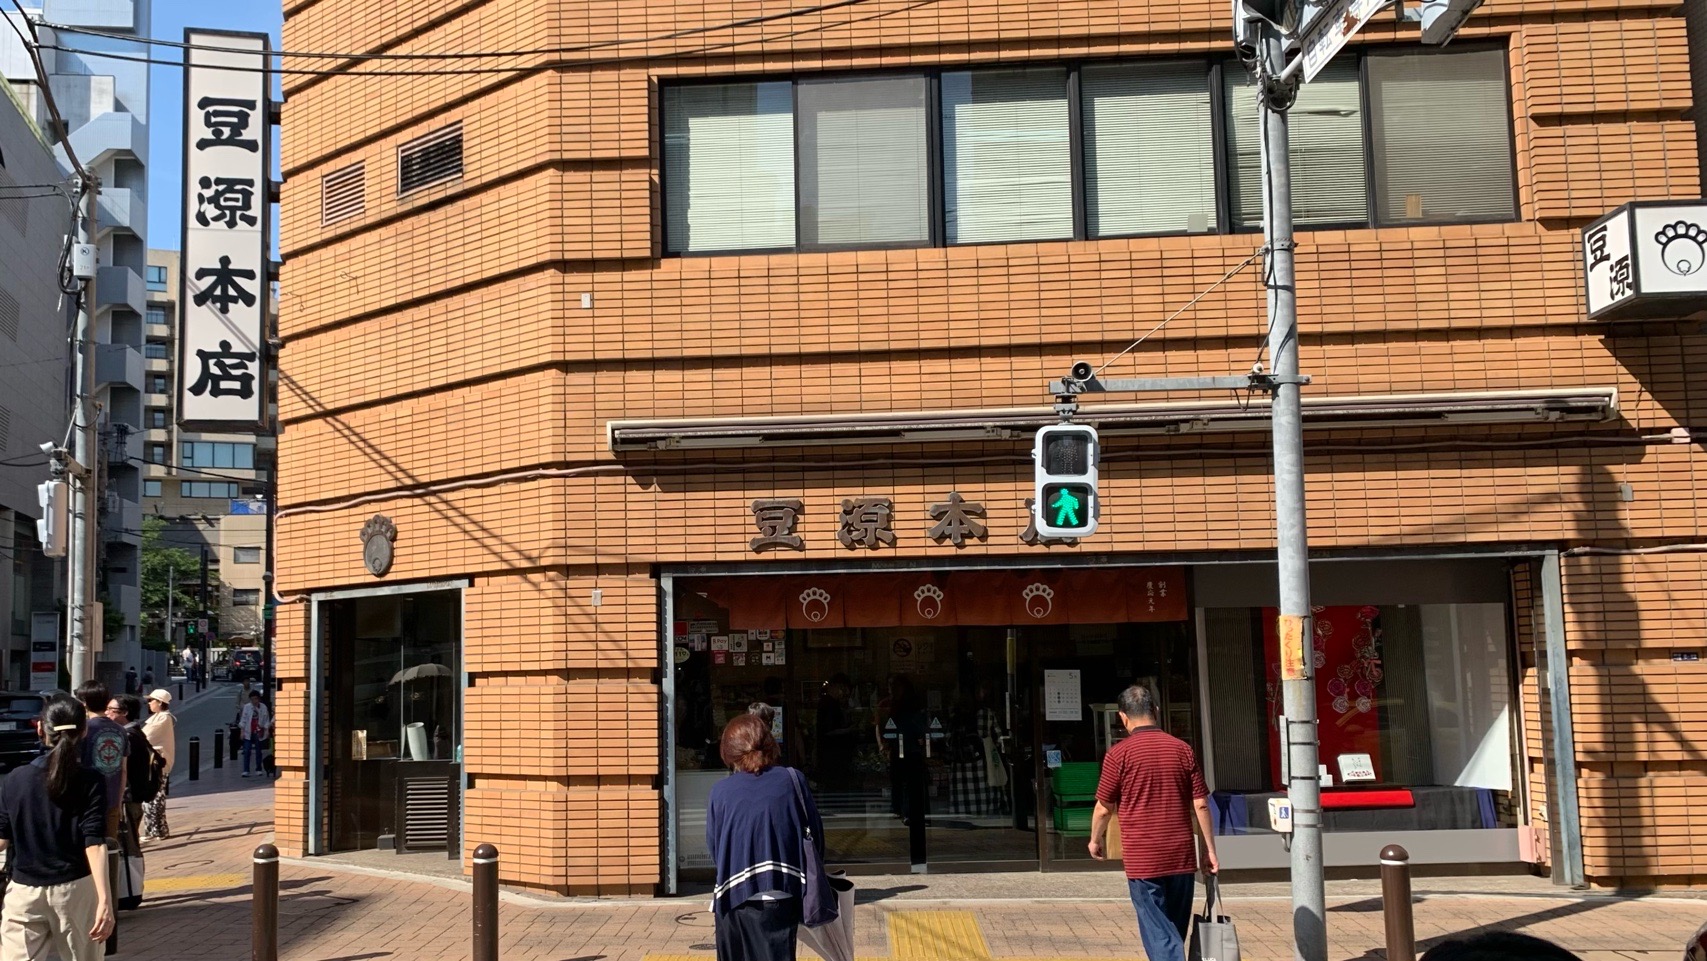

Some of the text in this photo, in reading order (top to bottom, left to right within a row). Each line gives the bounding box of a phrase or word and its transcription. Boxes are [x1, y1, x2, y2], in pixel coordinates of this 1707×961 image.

[187, 96, 260, 400] 豆源本店
[1587, 224, 1634, 301] 豆源
